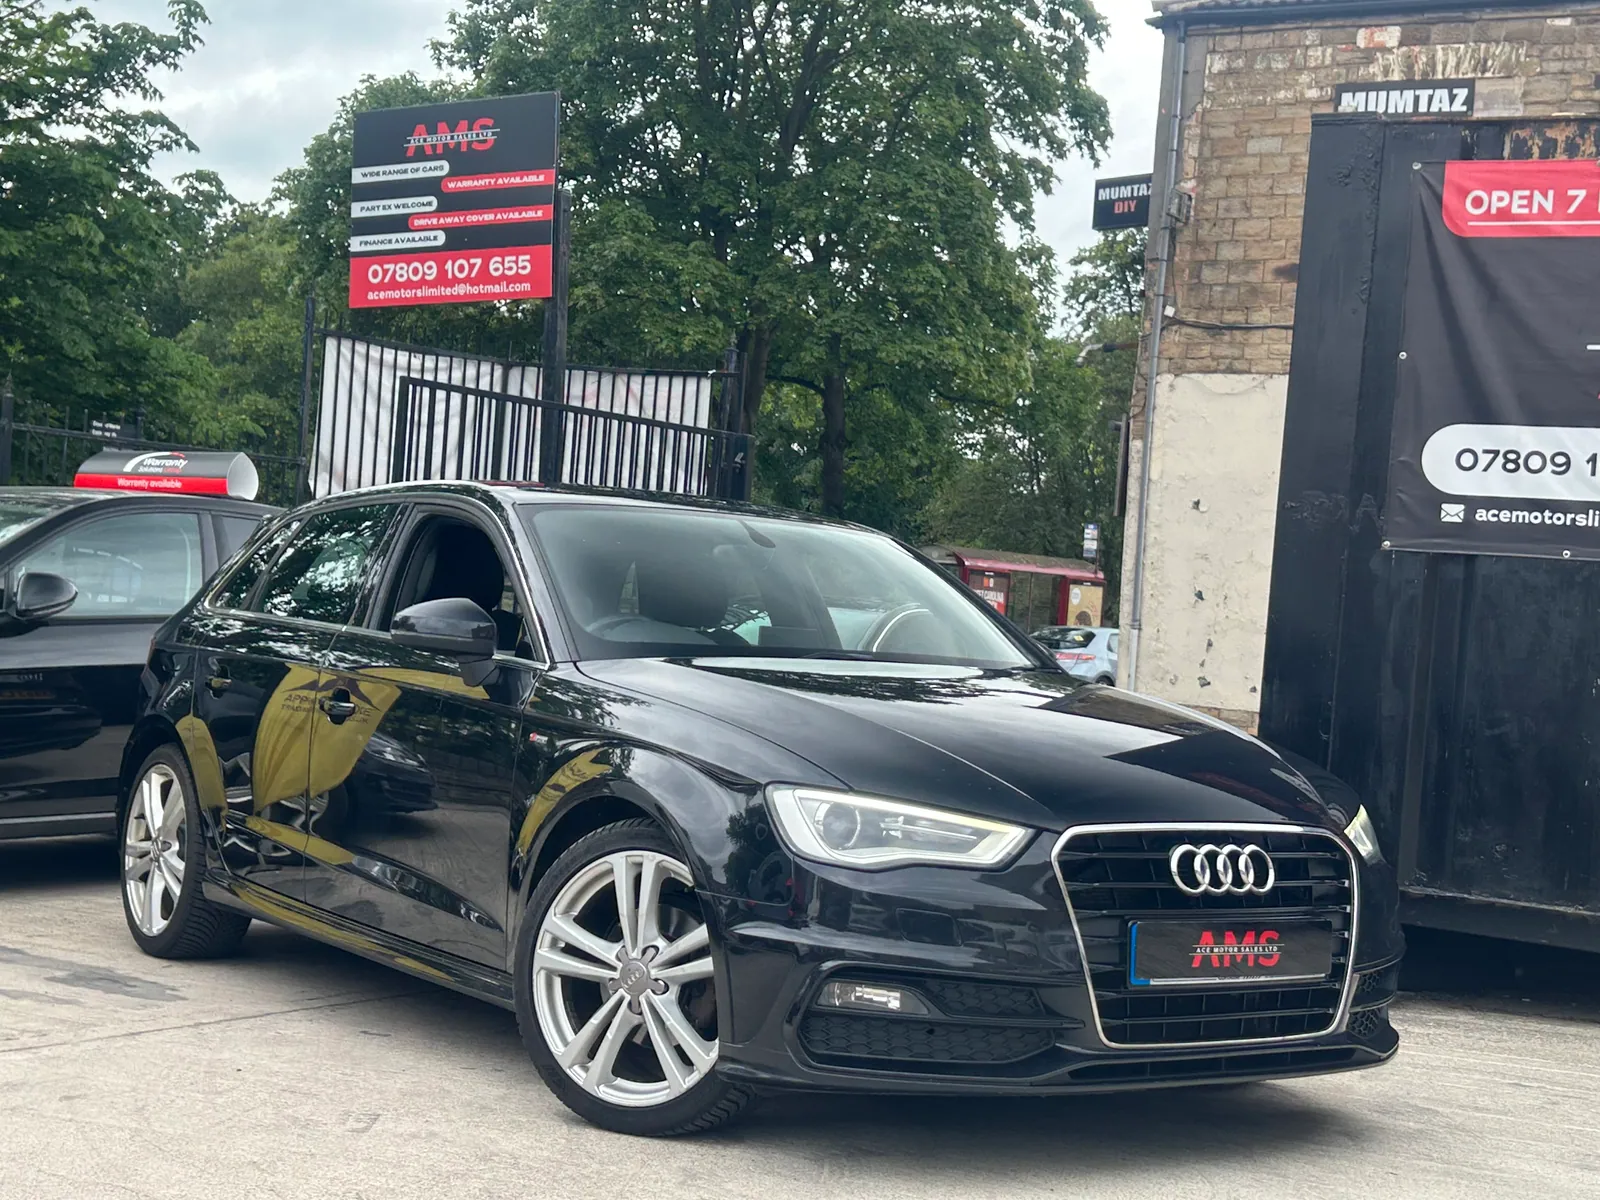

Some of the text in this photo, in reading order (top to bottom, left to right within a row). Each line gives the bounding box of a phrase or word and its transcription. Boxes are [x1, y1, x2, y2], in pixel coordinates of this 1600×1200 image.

[1339, 88, 1469, 113] MUMTAZ
[406, 117, 495, 157] AMS
[410, 137, 424, 145] ACE
[426, 135, 451, 143] MOTOR
[360, 164, 444, 178] WIDE RANGE OF CARS
[447, 174, 545, 188] WARRANTY AVAILABLE
[360, 200, 434, 213] PART EX WELCOME
[1114, 200, 1137, 214] DIY
[1465, 189, 1554, 215] OPEN
[1567, 189, 1587, 214] 7
[414, 210, 544, 226] DRIVE AWAY COVER AVAILABLE
[359, 235, 439, 247] FINANCE AVAILABLE
[367, 254, 531, 284] 07809 107 655
[367, 281, 531, 300] acemotorslimited@hotmail.com
[143, 458, 188, 469] Warranty
[1455, 448, 1571, 476] 07809
[117, 478, 183, 490] Warranty available
[1191, 930, 1280, 968] AMS
